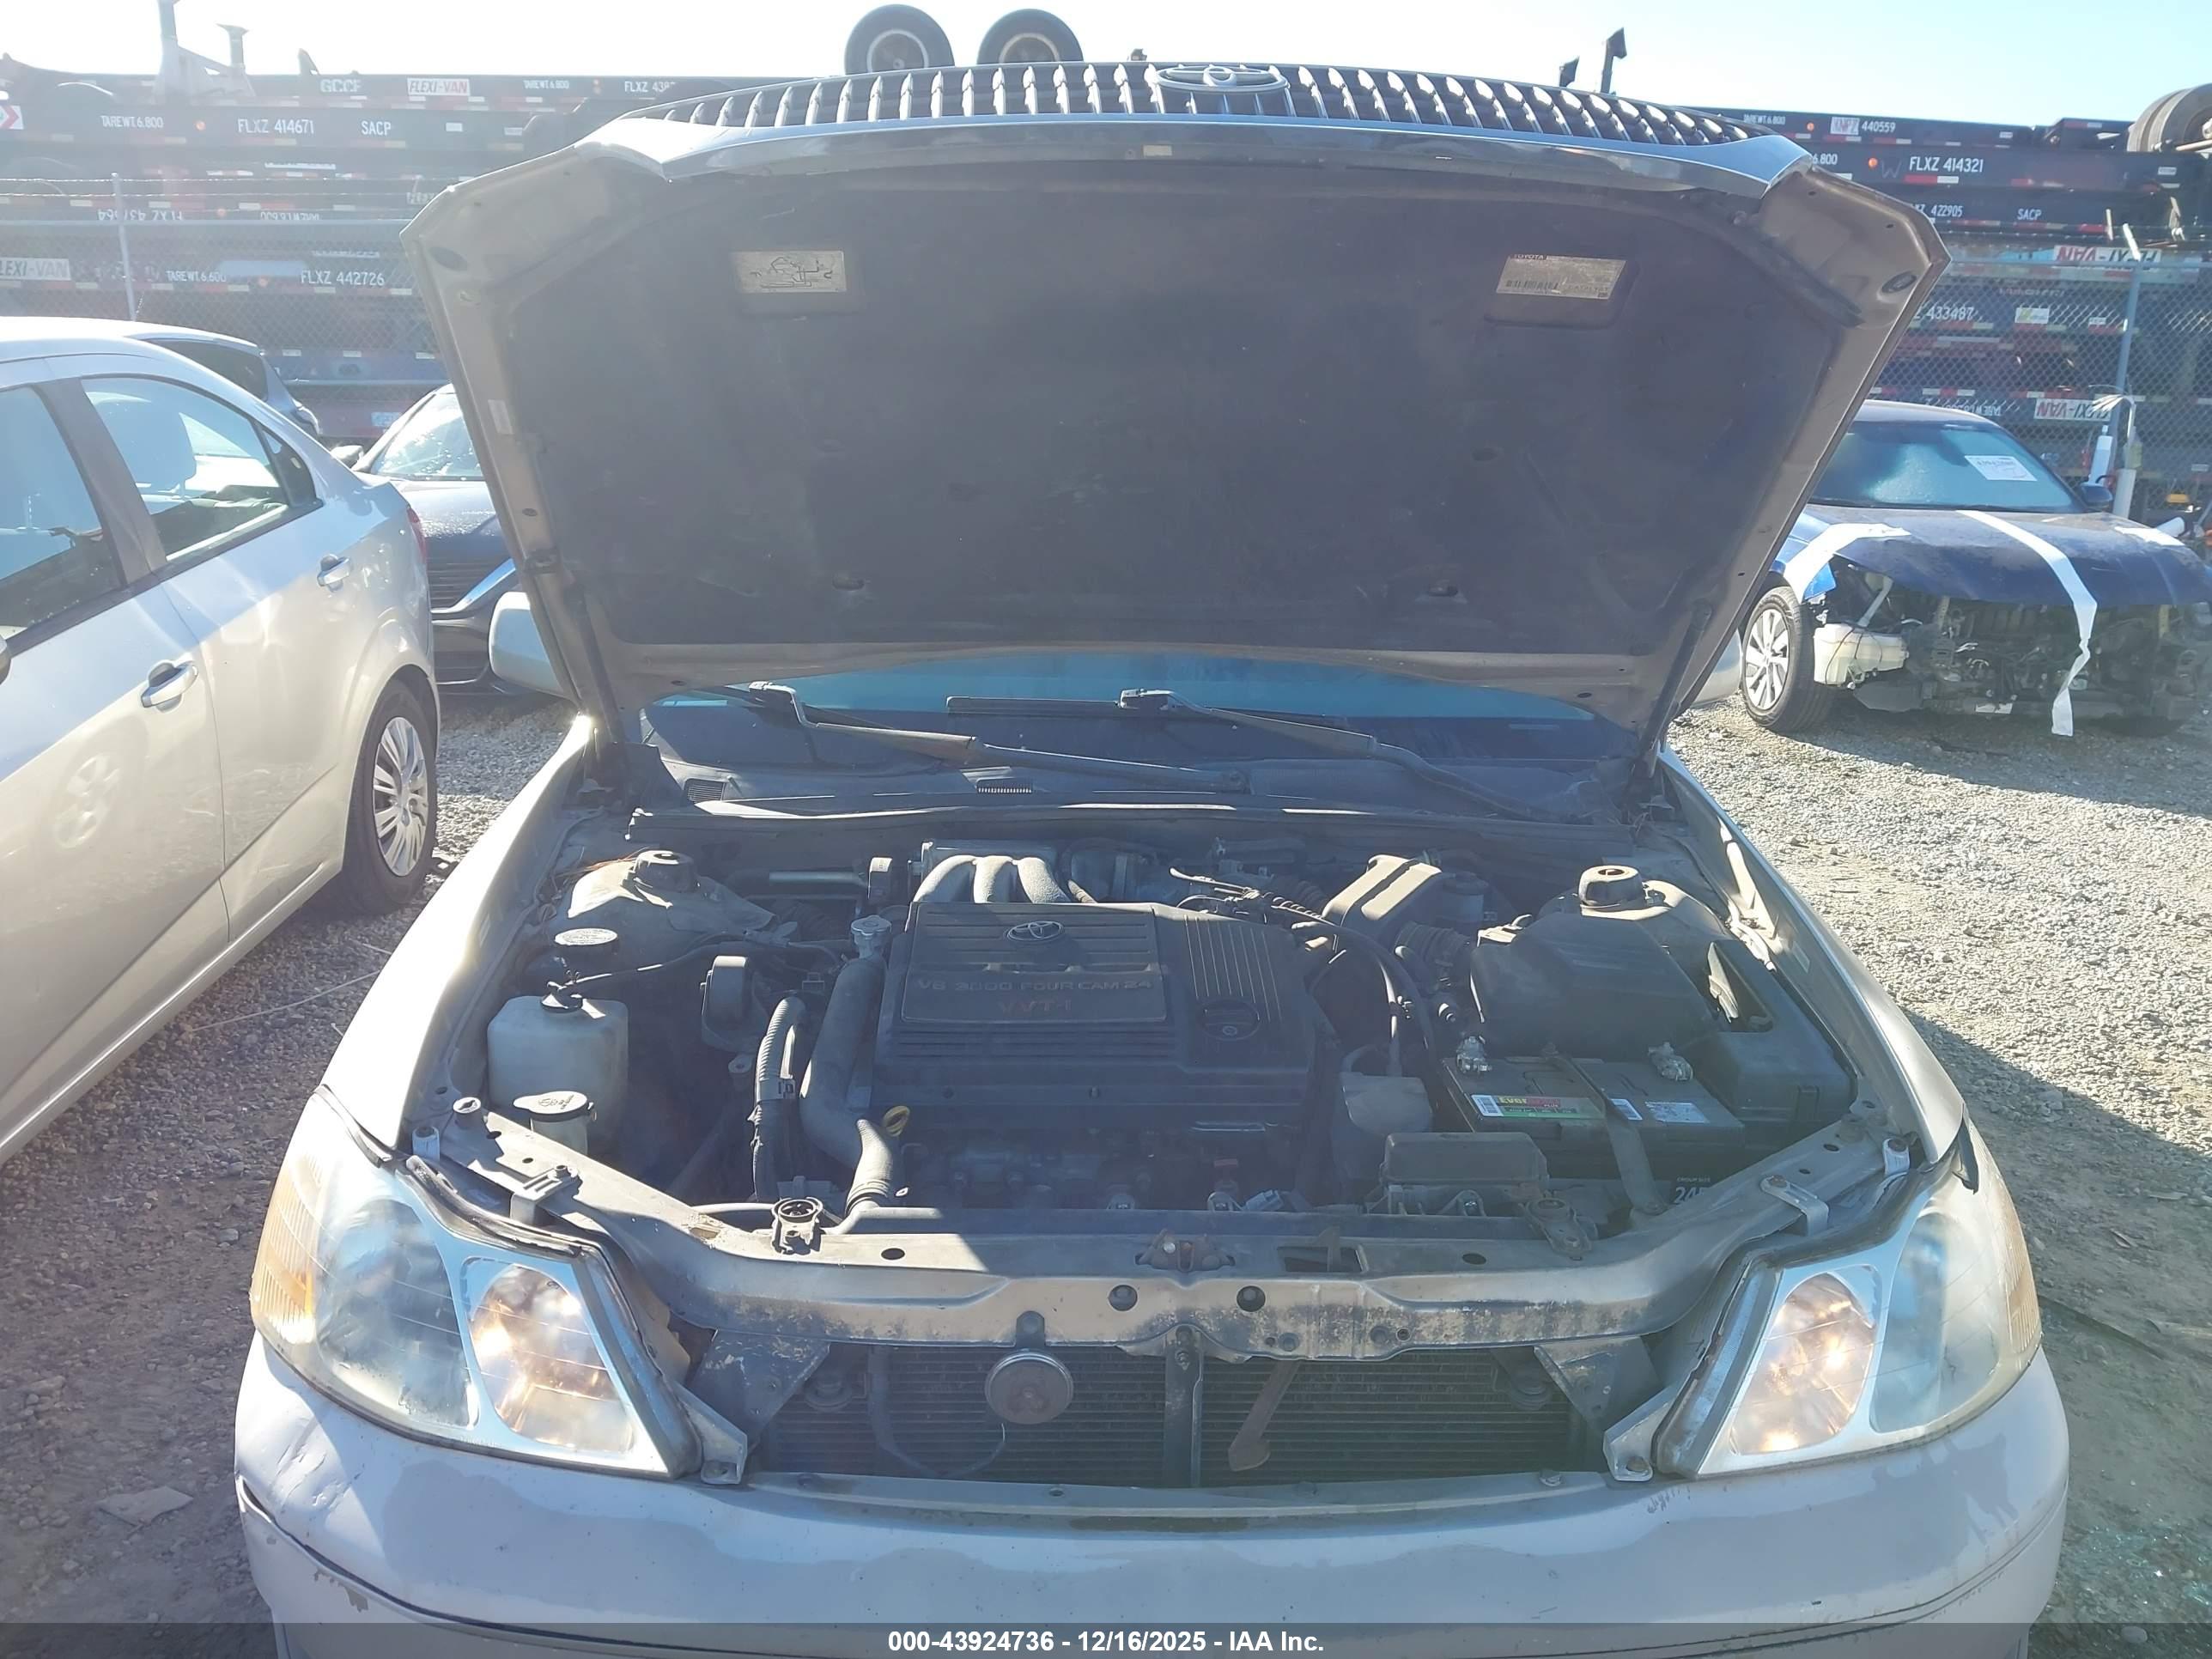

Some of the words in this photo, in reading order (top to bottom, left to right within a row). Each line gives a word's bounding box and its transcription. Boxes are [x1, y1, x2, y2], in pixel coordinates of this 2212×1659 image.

[409, 80, 467, 94] FLEXI-VAN
[624, 81, 648, 93] FLXZ
[237, 119, 270, 134] FLXZ
[274, 119, 313, 134] 414671
[361, 121, 392, 135] SACP
[1861, 120, 1896, 133] 440559
[1909, 156, 1940, 171] FLXZ
[1942, 158, 1984, 173] 414321
[1930, 205, 1963, 217] 422905
[2017, 209, 2042, 221] SACP
[301, 270, 331, 284] FLXZ
[336, 271, 385, 286] 442726
[1925, 306, 1974, 321] 433487
[917, 979, 946, 991] V6
[1019, 981, 1075, 991] FOUR
[1078, 980, 1120, 990] CAM
[1123, 979, 1153, 990] 24
